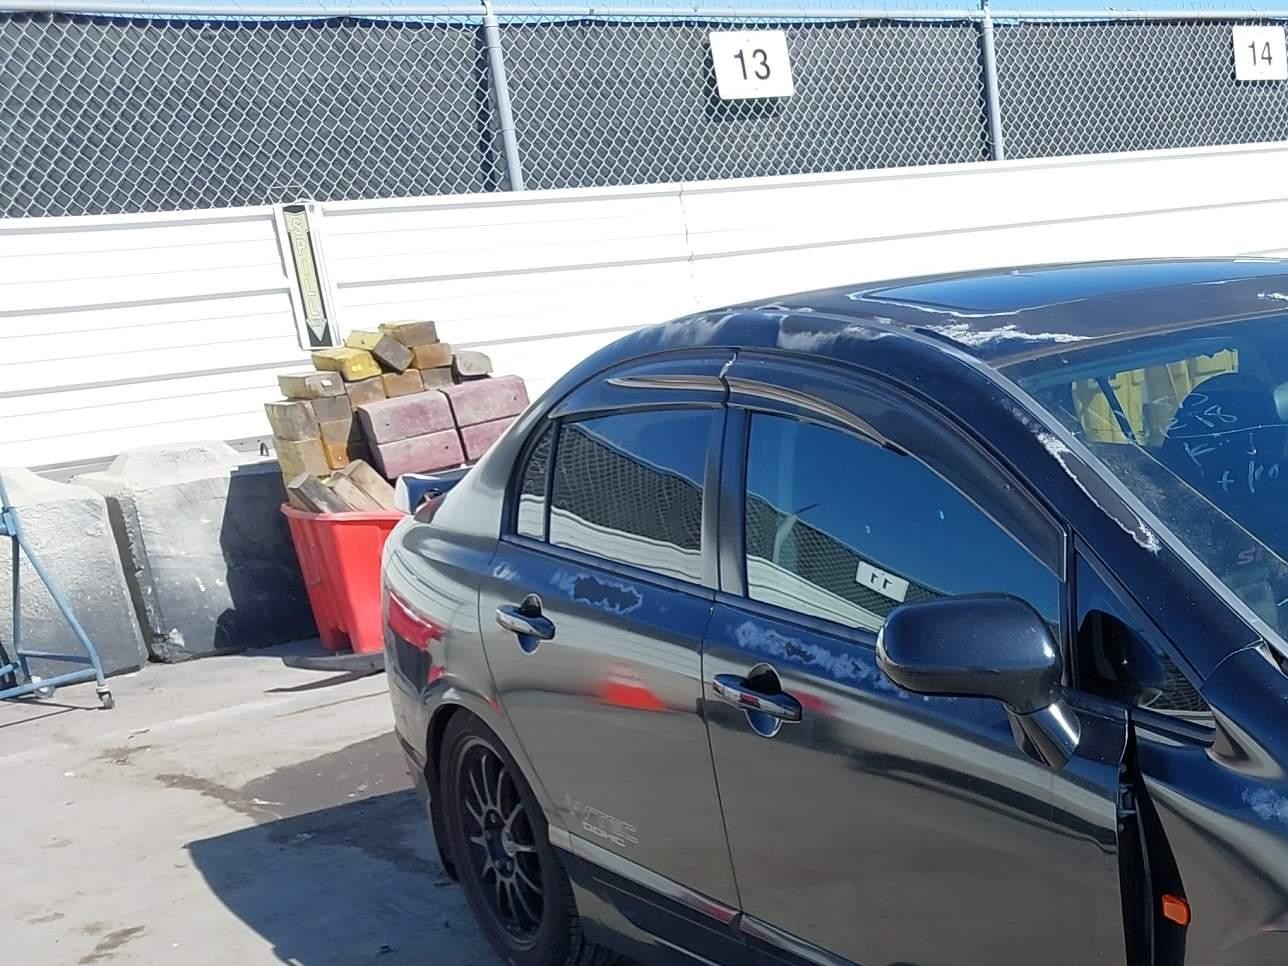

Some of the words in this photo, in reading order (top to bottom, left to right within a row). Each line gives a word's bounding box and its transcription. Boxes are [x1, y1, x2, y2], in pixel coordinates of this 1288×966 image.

[734, 48, 771, 80] 13
[1248, 40, 1272, 66] 14
[292, 218, 320, 317] SPILL
